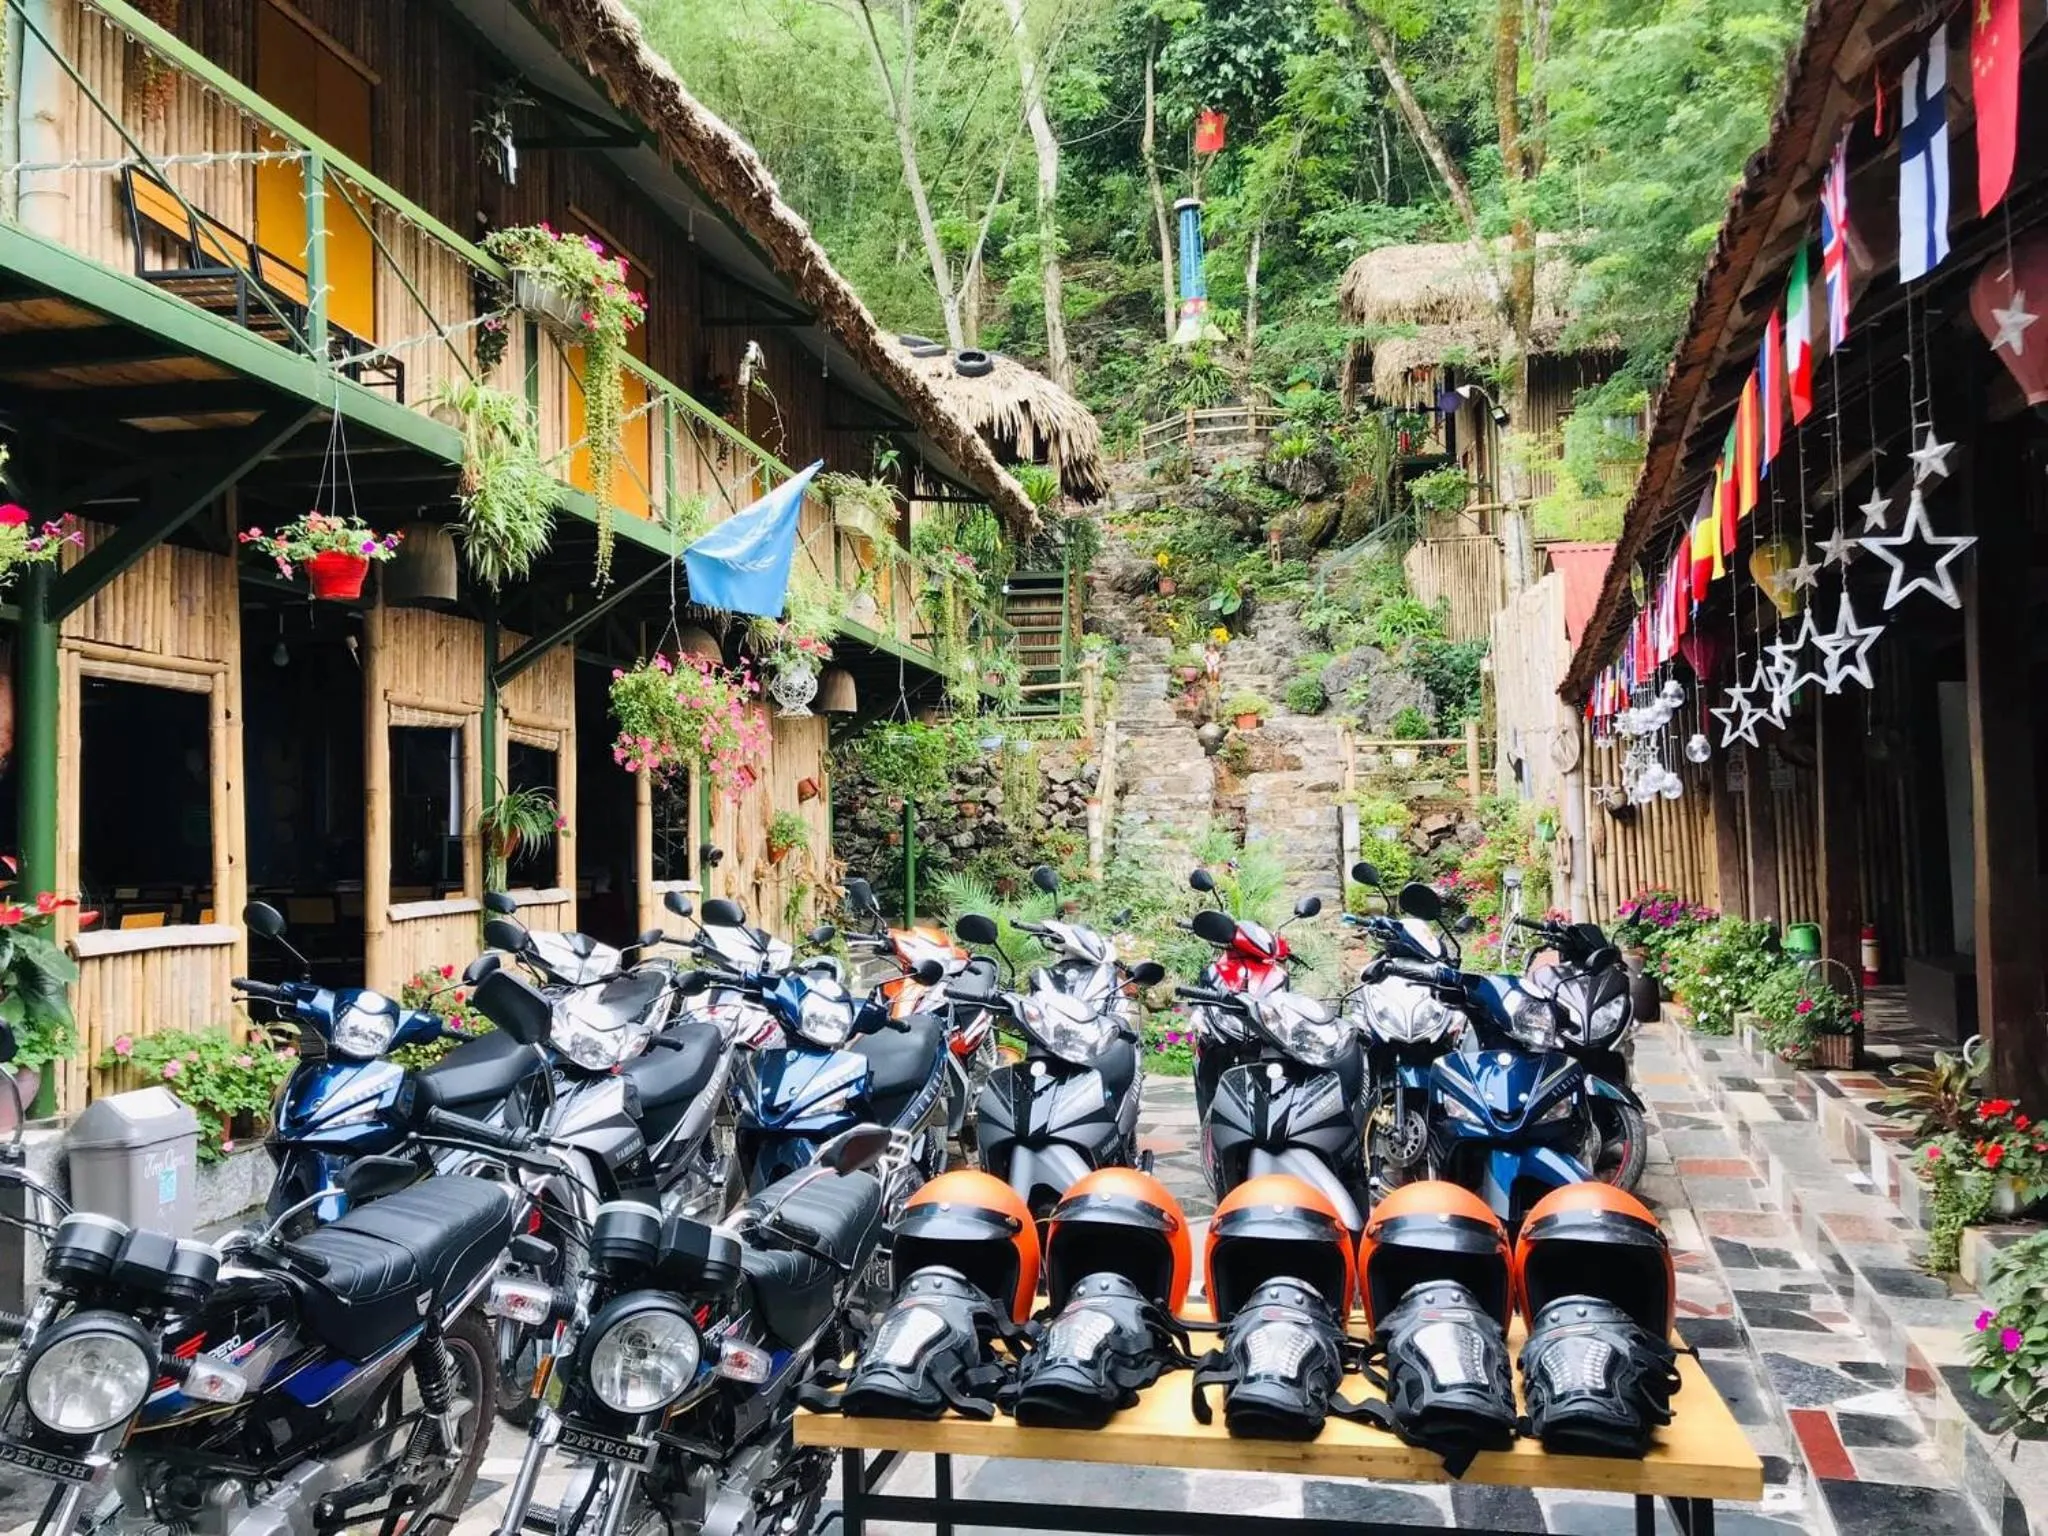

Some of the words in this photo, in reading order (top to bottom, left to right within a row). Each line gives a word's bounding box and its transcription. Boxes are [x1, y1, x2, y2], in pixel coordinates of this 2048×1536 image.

[400, 1144, 421, 1160] MAHA
[562, 1429, 643, 1461] DETECH
[0, 1445, 91, 1478] DETECH
